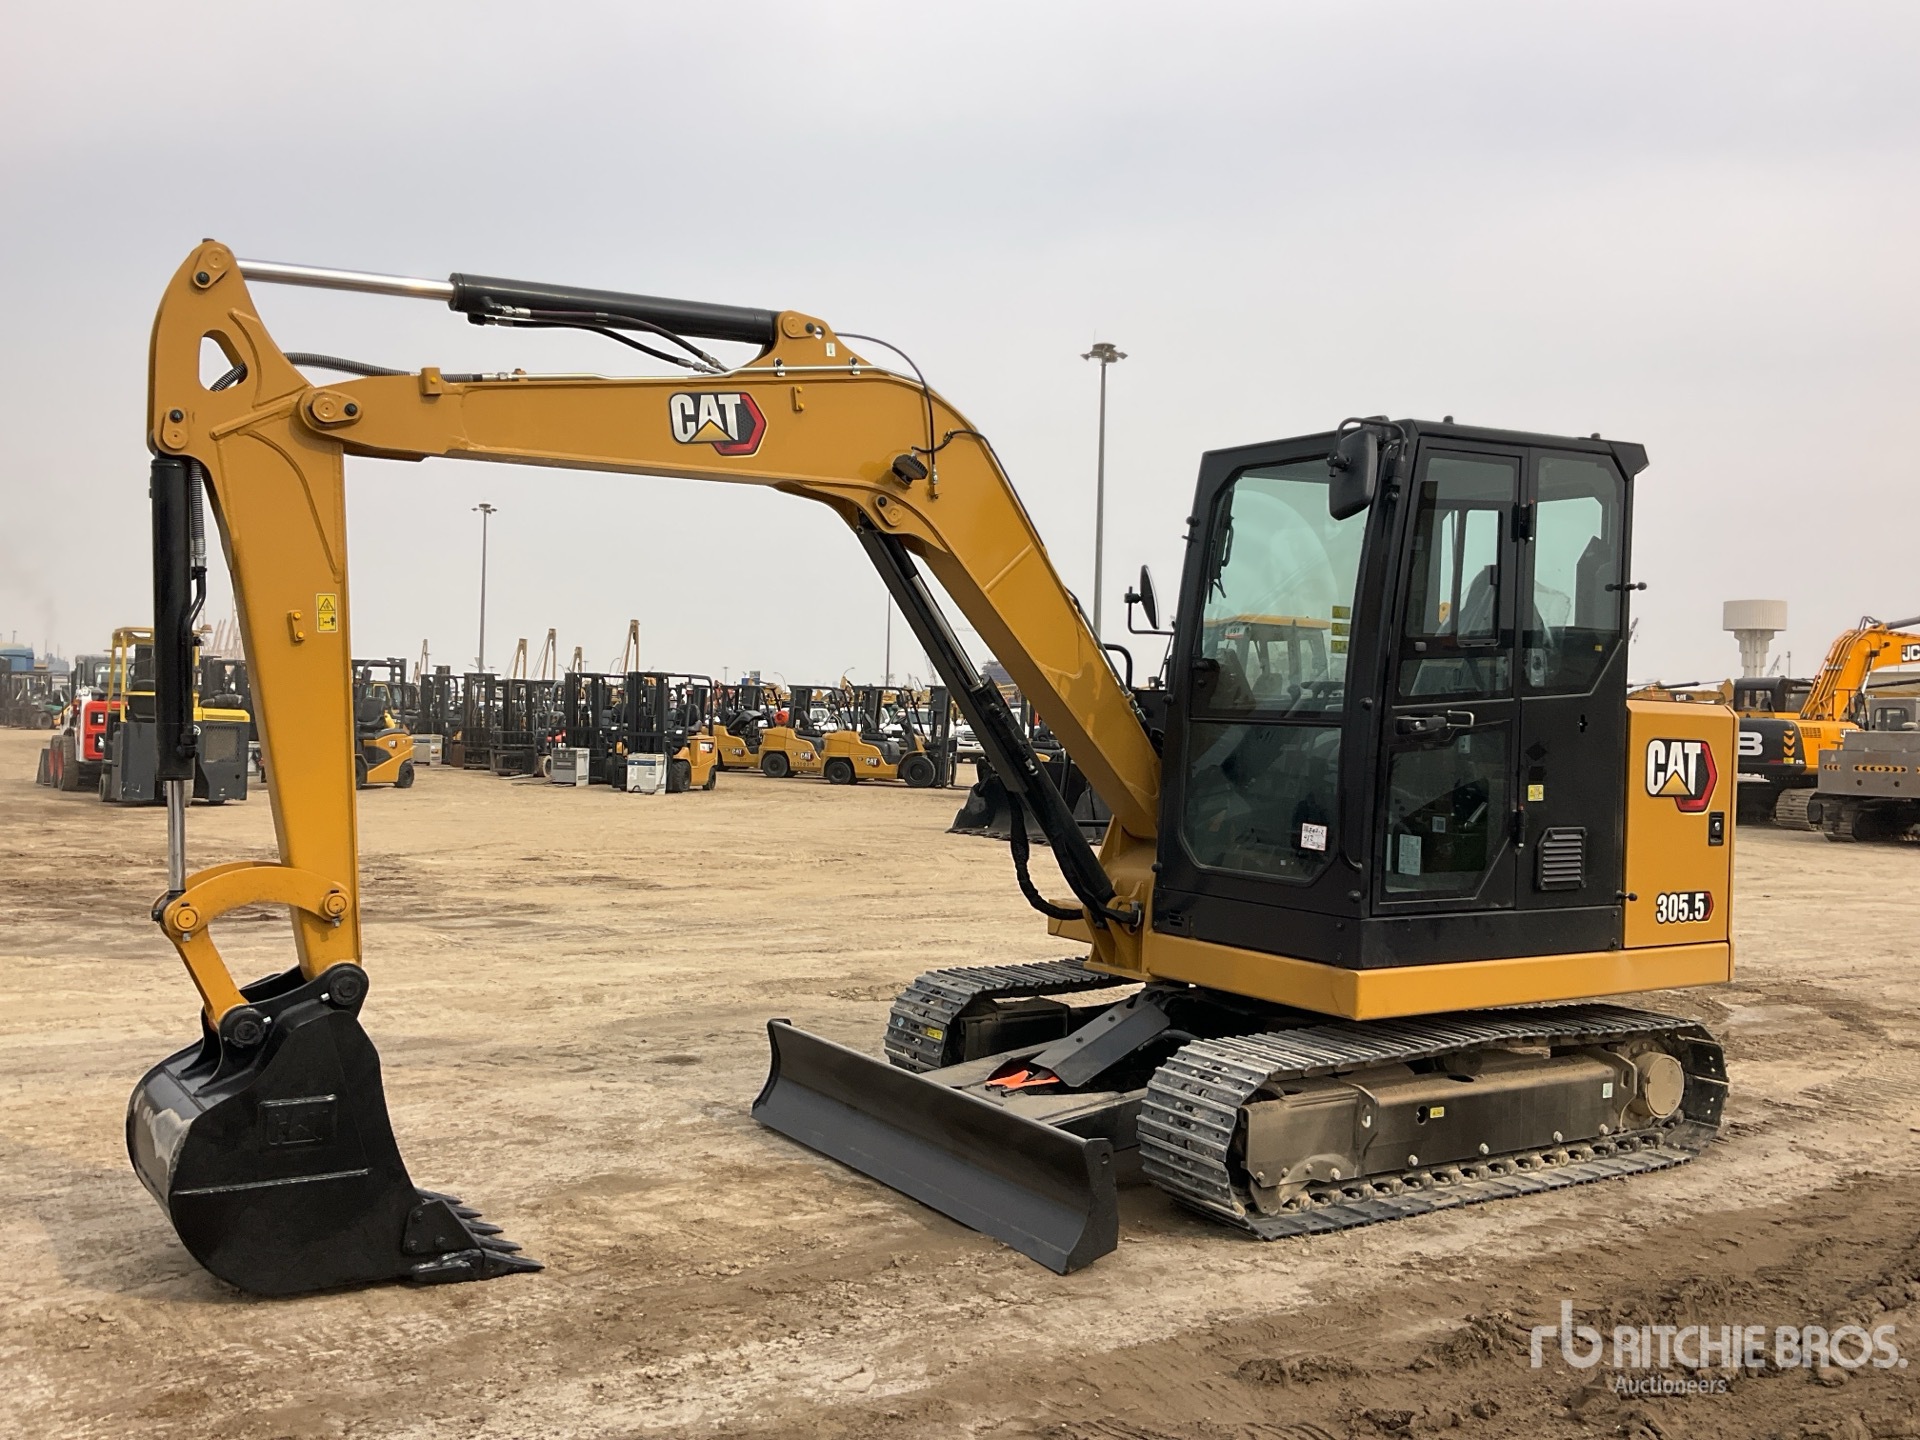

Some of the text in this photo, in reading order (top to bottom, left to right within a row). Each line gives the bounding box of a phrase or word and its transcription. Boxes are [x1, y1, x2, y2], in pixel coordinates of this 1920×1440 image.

[670, 393, 741, 443] CAT
[800, 752, 811, 760] CAT
[865, 757, 877, 766] CAT
[1647, 739, 1702, 796] CAT
[1656, 892, 1705, 922] 305.5
